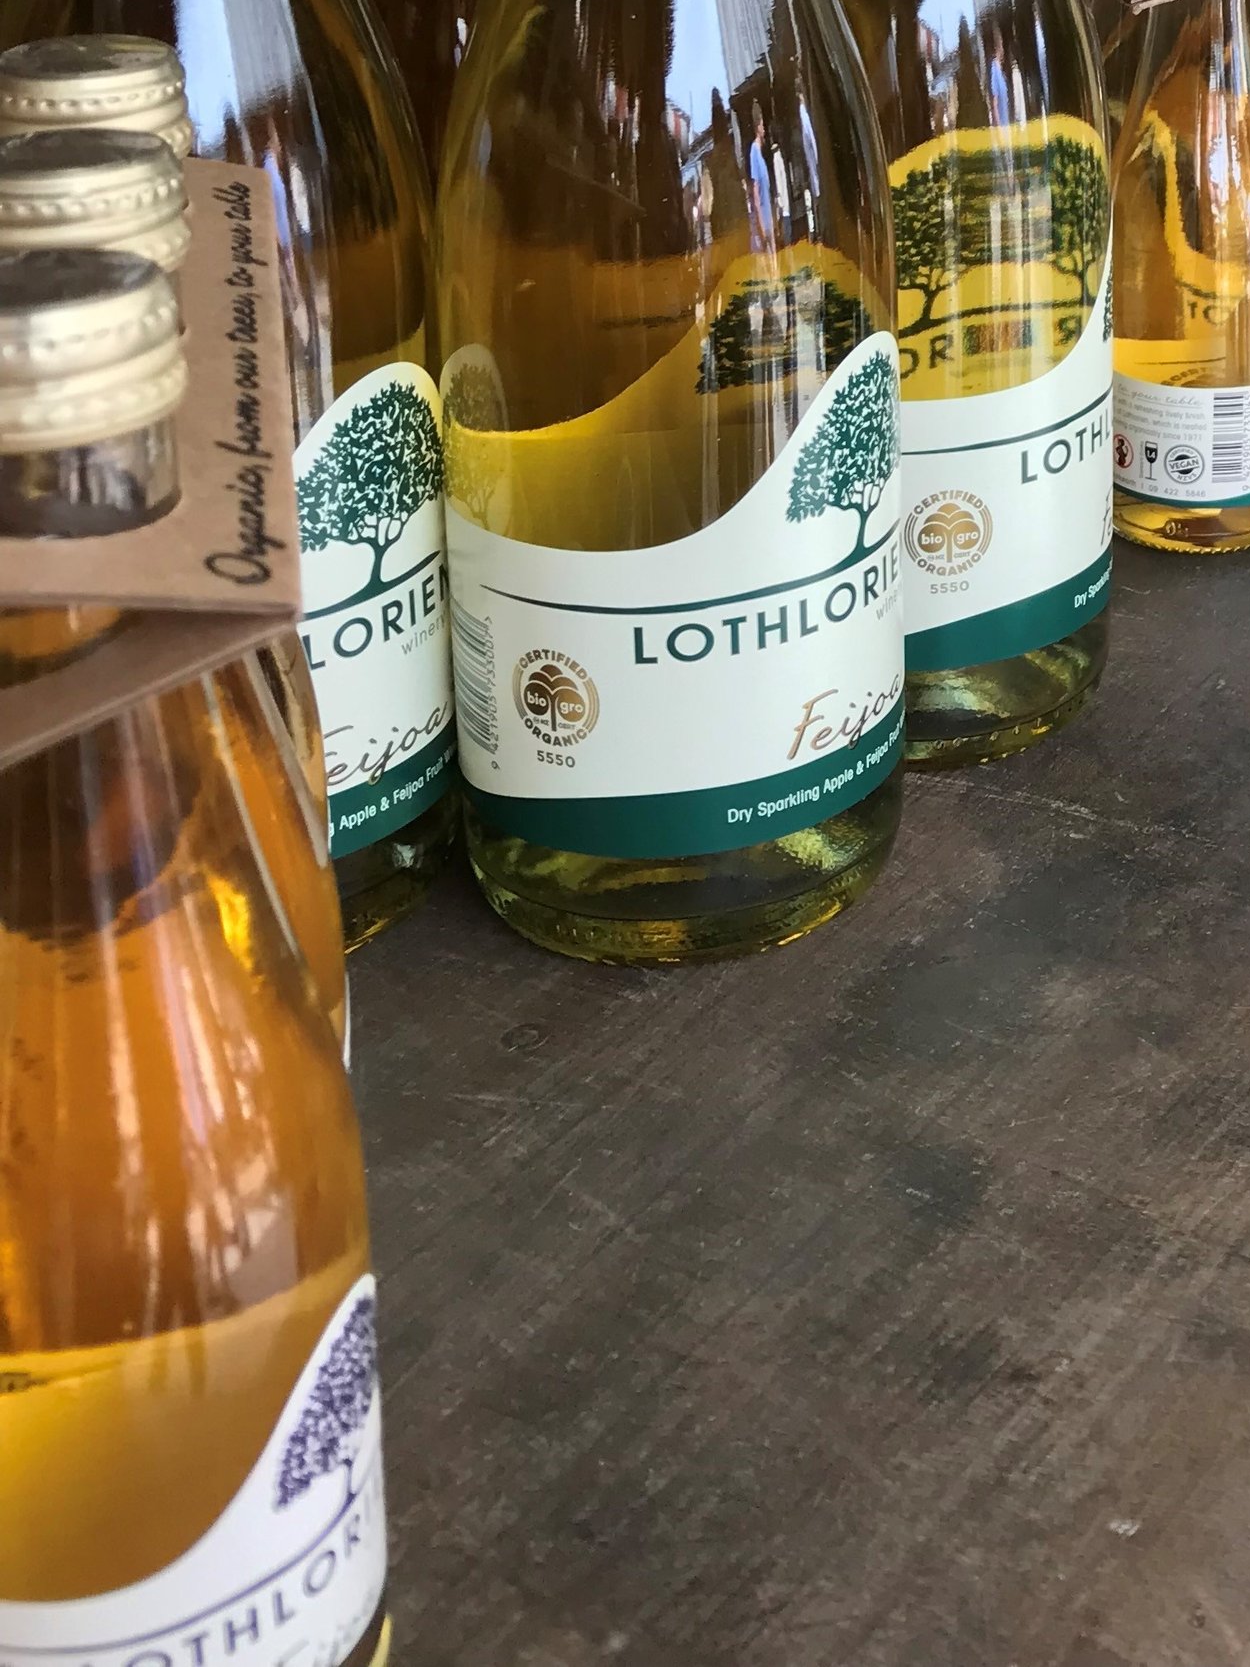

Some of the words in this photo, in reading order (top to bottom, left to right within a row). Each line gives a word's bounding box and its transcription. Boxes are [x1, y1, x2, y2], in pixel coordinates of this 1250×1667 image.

[230, 226, 269, 267] your
[225, 264, 255, 288] to
[215, 392, 273, 460] from
[1168, 458, 1200, 470] VEGAN
[913, 489, 984, 515] CERTIFIED
[921, 533, 943, 545] bio
[956, 531, 979, 545] gro
[916, 553, 983, 577] ORGANIC
[929, 580, 970, 595] 5550
[1074, 590, 1088, 609] Dry
[518, 649, 588, 681] CERTIFIED
[526, 690, 547, 708] bio
[559, 701, 584, 715] gro
[524, 717, 588, 747] ORGANIC
[536, 749, 576, 769] 5550
[727, 806, 753, 824] Dry
[757, 785, 820, 818] Sparkling
[823, 768, 854, 794] Apple
[856, 760, 865, 776] &
[865, 740, 889, 769] Feijoa
[339, 802, 377, 831] Apple
[379, 796, 390, 812] &
[393, 776, 424, 805] Feijoa
